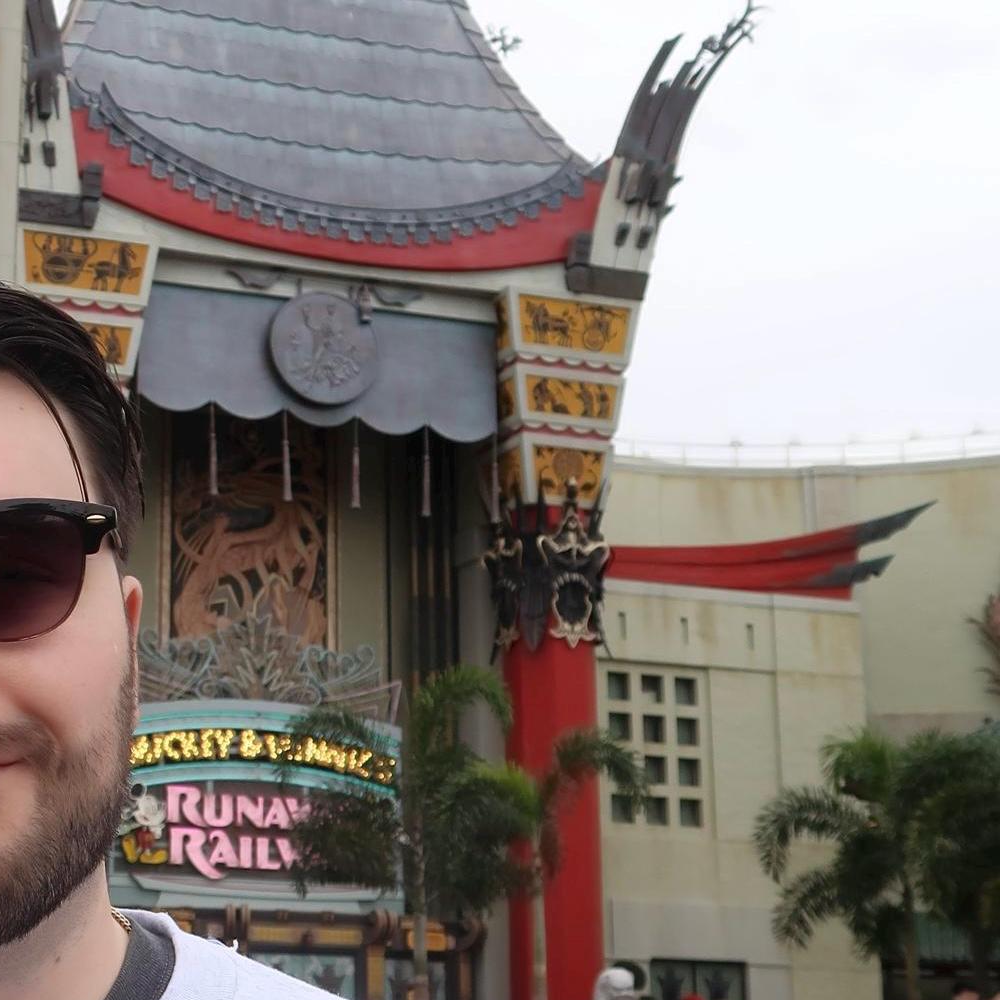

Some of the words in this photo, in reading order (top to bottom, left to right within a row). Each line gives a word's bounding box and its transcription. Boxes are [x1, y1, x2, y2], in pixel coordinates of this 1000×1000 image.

[239, 728, 263, 757] &
[165, 785, 315, 829] RUNA
[166, 827, 302, 879] RAIL
